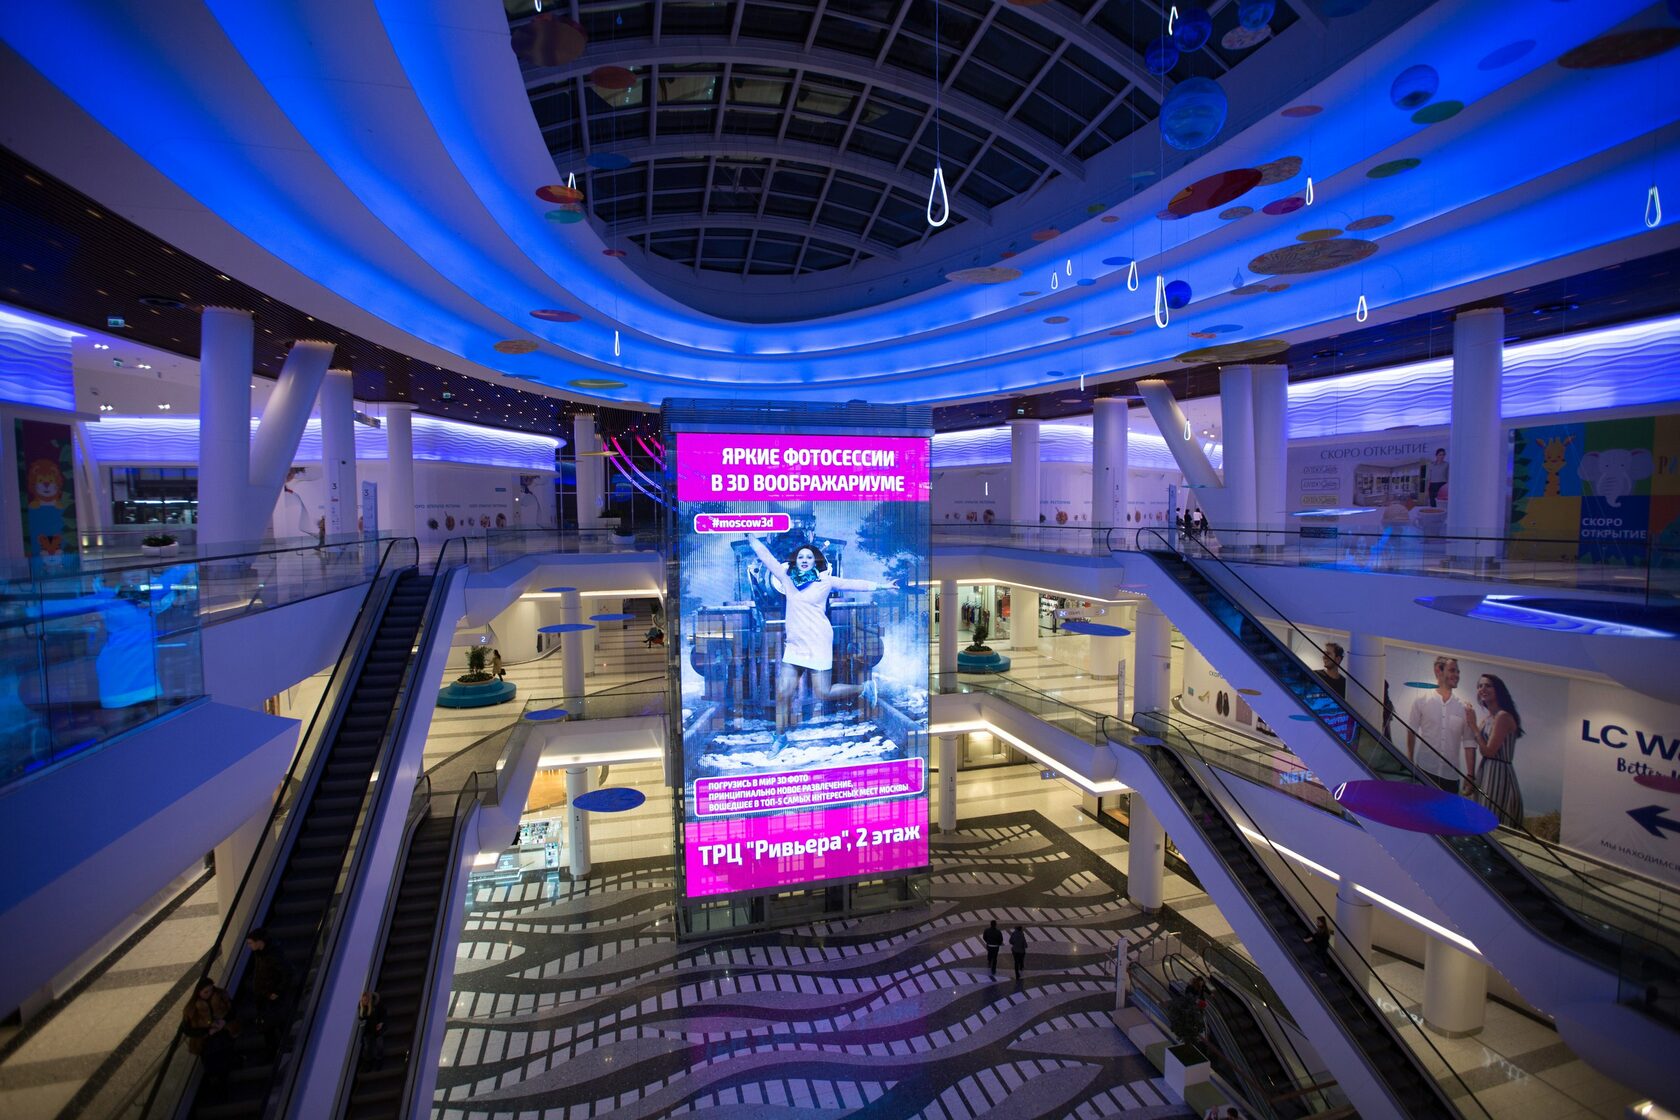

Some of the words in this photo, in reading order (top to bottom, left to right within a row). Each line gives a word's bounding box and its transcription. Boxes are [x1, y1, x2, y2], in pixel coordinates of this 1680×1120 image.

[721, 447, 780, 465] ЯРКИЕ
[783, 447, 895, 467] ФОТОСЕССИИ
[1320, 447, 1360, 460] СКОРО
[1363, 442, 1430, 457] ОТКРЫТИЕ
[711, 474, 723, 492] В
[726, 474, 749, 492] 3D
[753, 474, 905, 492] ВООБРАЖАРИУМЕ
[712, 516, 774, 528] #moscow3d
[1582, 517, 1623, 527] СКОРО
[1581, 529, 1647, 539] ОТКРЫТИЕ
[1582, 719, 1628, 749] LC
[1635, 730, 1680, 761] W
[708, 780, 752, 790] ПОГРУЗИСЬ
[752, 779, 758, 787] В
[759, 777, 776, 786] МИР
[777, 776, 787, 784] 3D
[788, 774, 808, 784] ФОТО
[708, 787, 776, 801] ПРИНЦИПИАЛЬНО
[777, 785, 802, 795] НОВОЕ
[709, 800, 753, 811] ВОШЕДШЕЕ
[761, 797, 783, 807] ТОП-5
[783, 795, 811, 805] САМЫХ
[811, 788, 859, 802] ИНТЕРЕСНЫХ
[859, 786, 878, 796] МЕСТ
[879, 783, 909, 794] МОСКВЫ
[698, 843, 743, 866] ТРЦ
[746, 829, 852, 860] "Ривьера",
[856, 827, 868, 847] 2
[871, 825, 920, 846] этаж
[1601, 839, 1617, 851] МЫ
